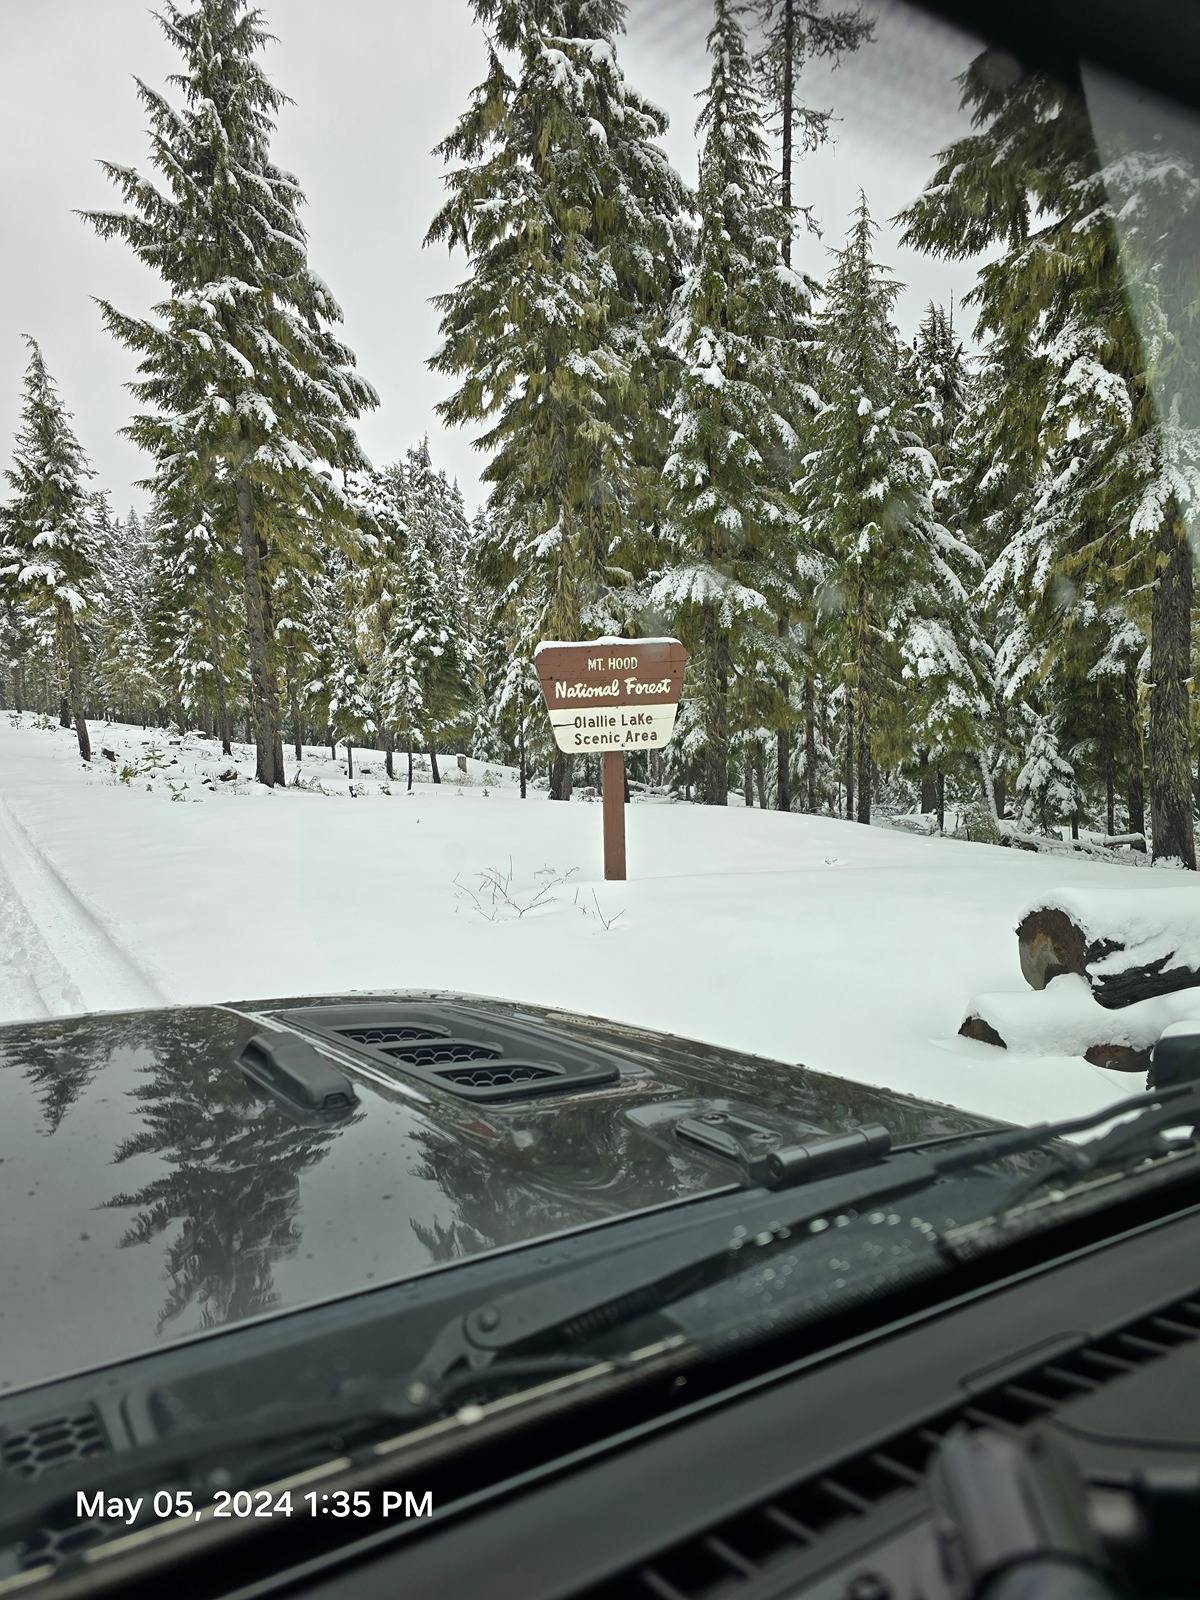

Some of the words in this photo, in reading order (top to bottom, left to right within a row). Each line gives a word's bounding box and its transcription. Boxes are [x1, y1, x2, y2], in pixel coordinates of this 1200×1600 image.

[588, 658, 605, 671] MT.
[608, 657, 638, 670] HOOD
[555, 679, 620, 699] National
[624, 677, 672, 695] Forest
[574, 715, 616, 729] Olallie
[574, 731, 621, 745] Scenic
[625, 730, 657, 743] Area
